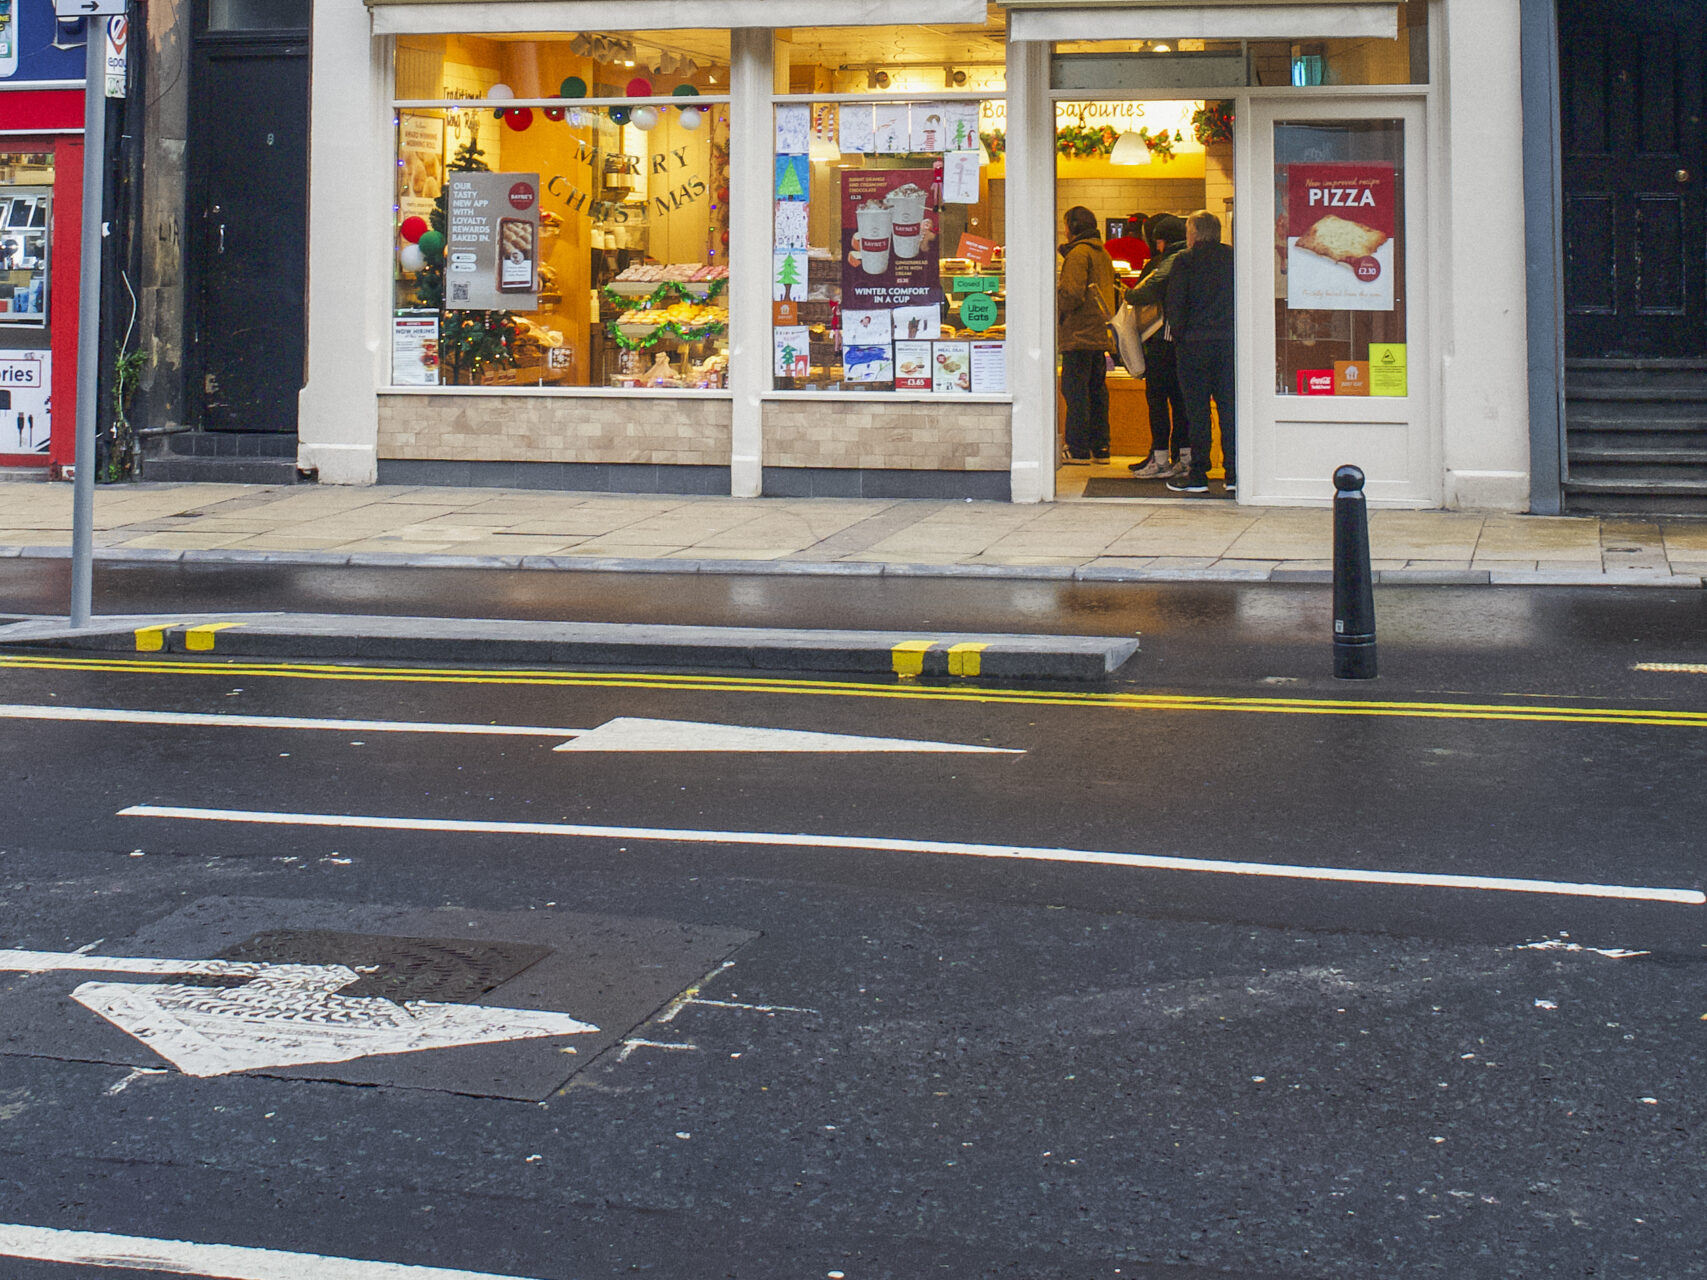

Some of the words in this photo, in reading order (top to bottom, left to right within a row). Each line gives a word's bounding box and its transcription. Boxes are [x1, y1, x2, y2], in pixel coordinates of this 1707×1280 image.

[1056, 102, 1145, 118] Savouries
[453, 182, 472, 190] OUR
[453, 191, 478, 199] TASTY
[1309, 188, 1376, 207] PIZZA
[453, 208, 474, 216] WITH
[452, 217, 487, 225] LOYALTY
[452, 225, 490, 233] REWARDS
[452, 234, 477, 242] BAKED
[957, 280, 980, 288] Closed
[855, 287, 887, 295] WINTER
[888, 287, 930, 295] COMFORT
[968, 304, 989, 312] Uber
[968, 313, 989, 321] Eats
[0, 365, 33, 382] ries
